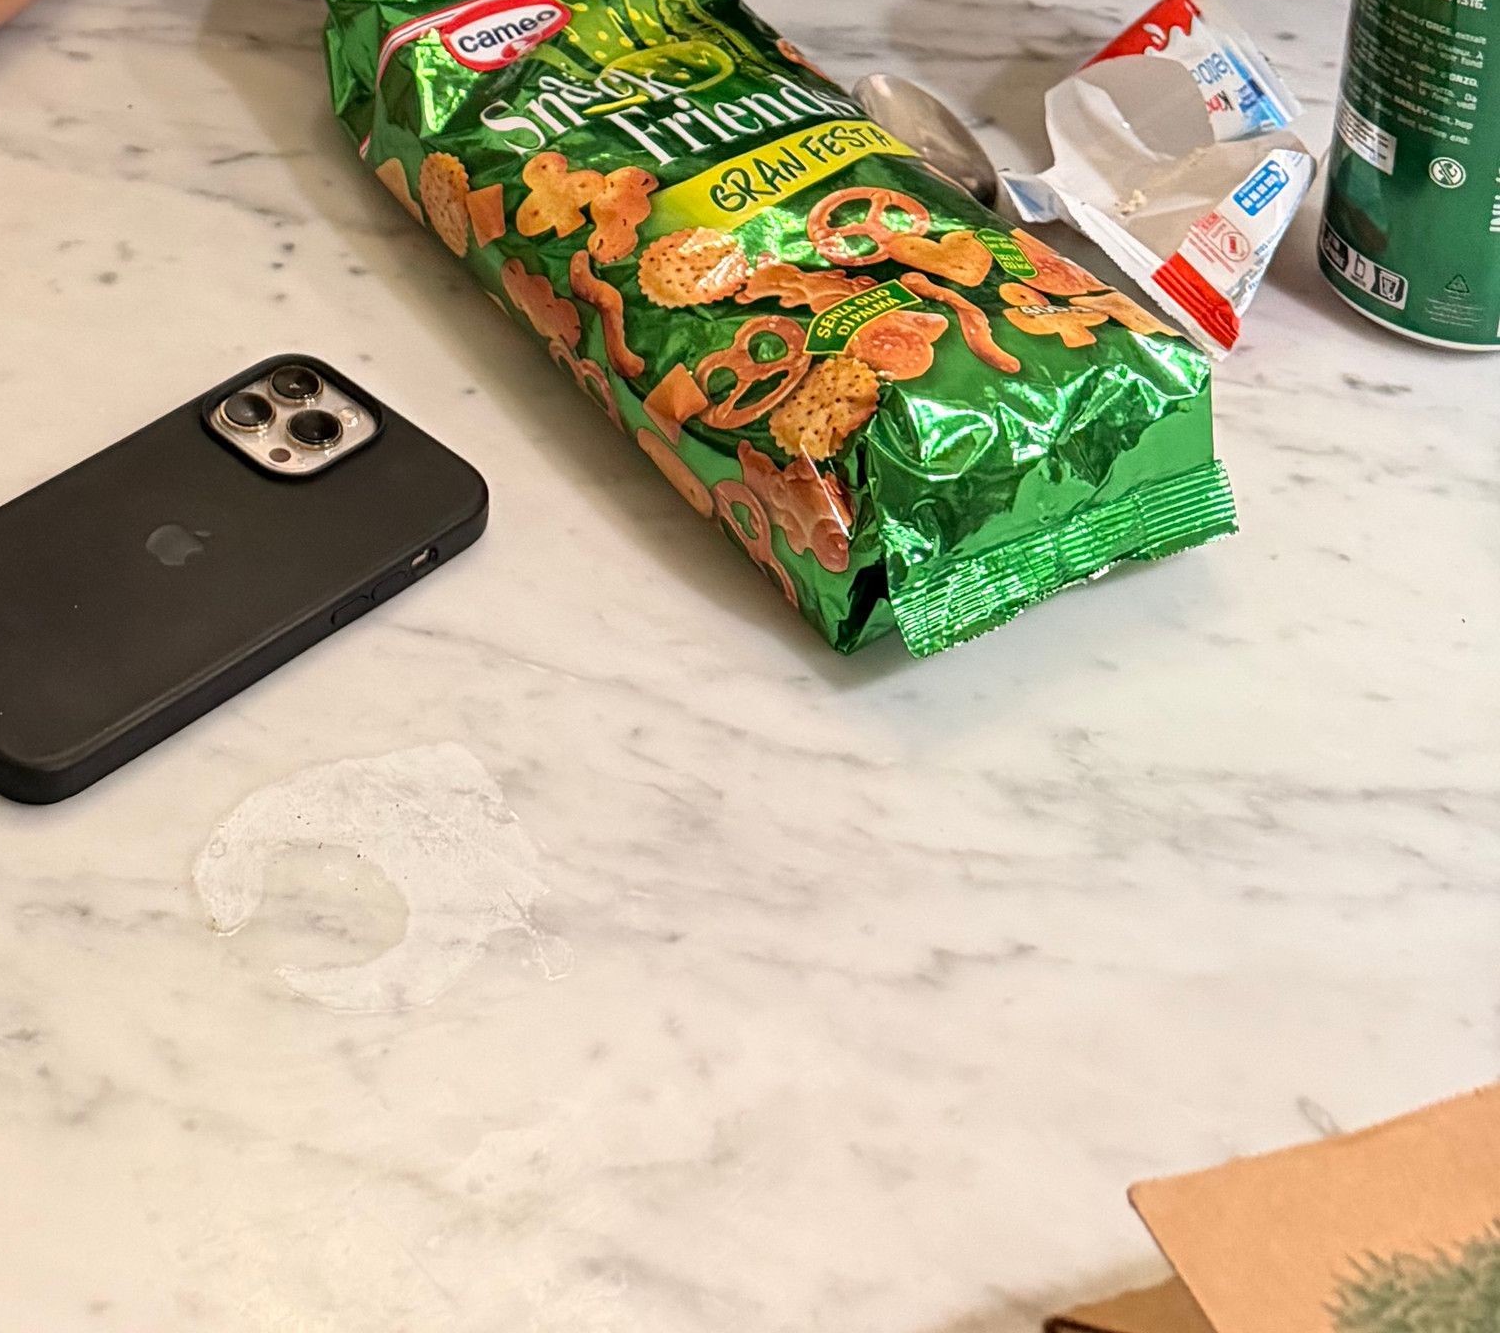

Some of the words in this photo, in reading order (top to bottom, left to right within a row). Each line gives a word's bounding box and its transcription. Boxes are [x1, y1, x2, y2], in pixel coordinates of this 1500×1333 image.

[457, 10, 557, 53] cameo
[480, 68, 688, 155] Snack
[604, 73, 860, 167] Friends
[709, 146, 808, 213] GRAN
[799, 125, 892, 163] FESTA
[816, 303, 857, 339] SENZA
[855, 288, 892, 307] OLIO
[836, 319, 855, 337] DI
[852, 296, 902, 323] PALMA
